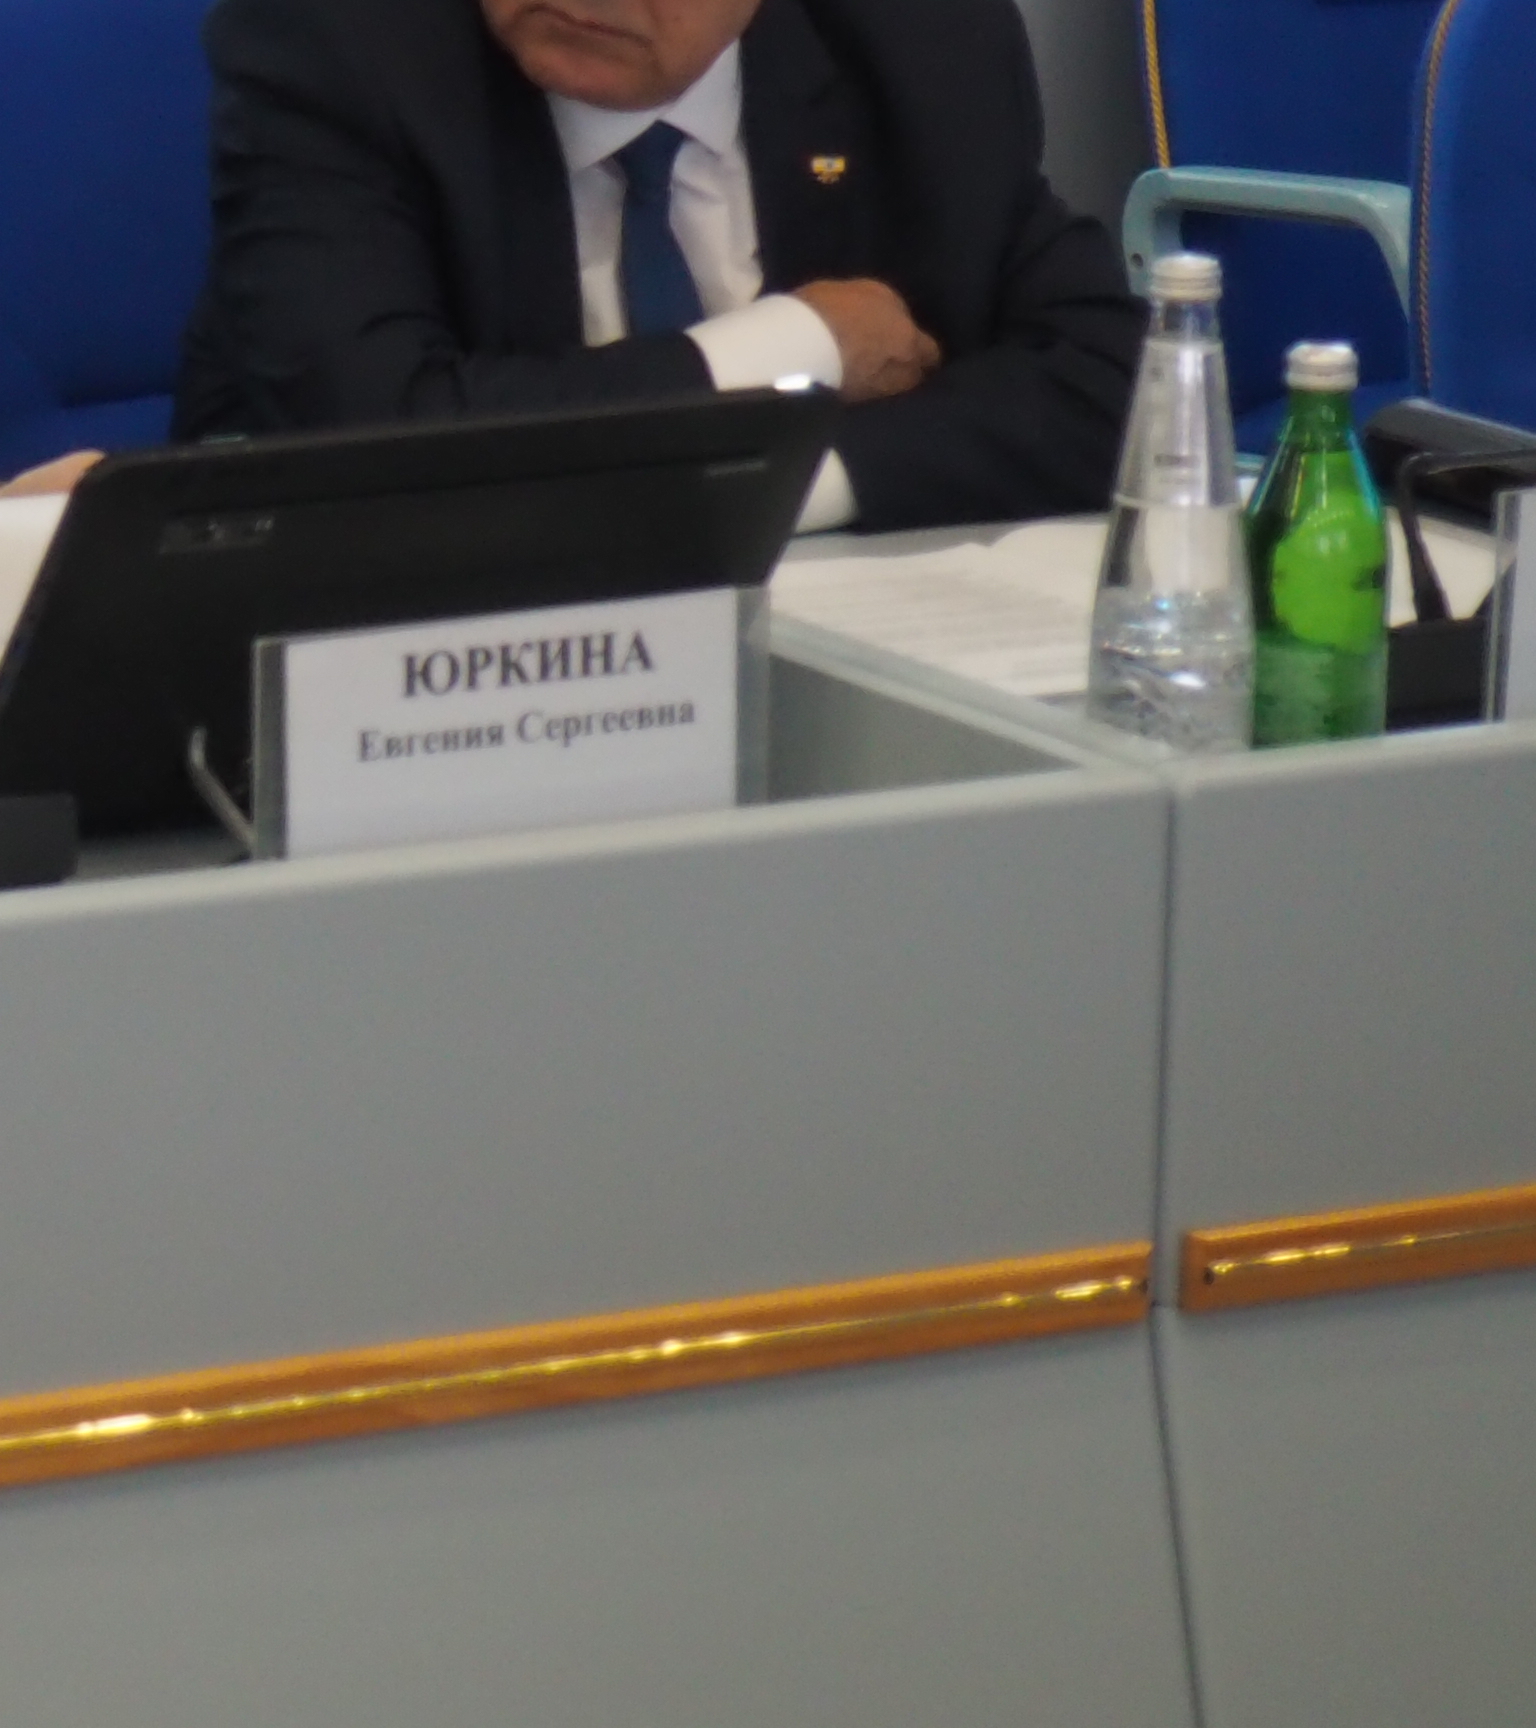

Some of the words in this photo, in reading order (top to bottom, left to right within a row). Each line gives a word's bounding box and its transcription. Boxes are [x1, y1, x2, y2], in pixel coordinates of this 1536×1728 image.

[401, 629, 655, 698] ЮРКИНА
[358, 719, 505, 763] Евгения
[517, 698, 696, 746] Сергеевна
